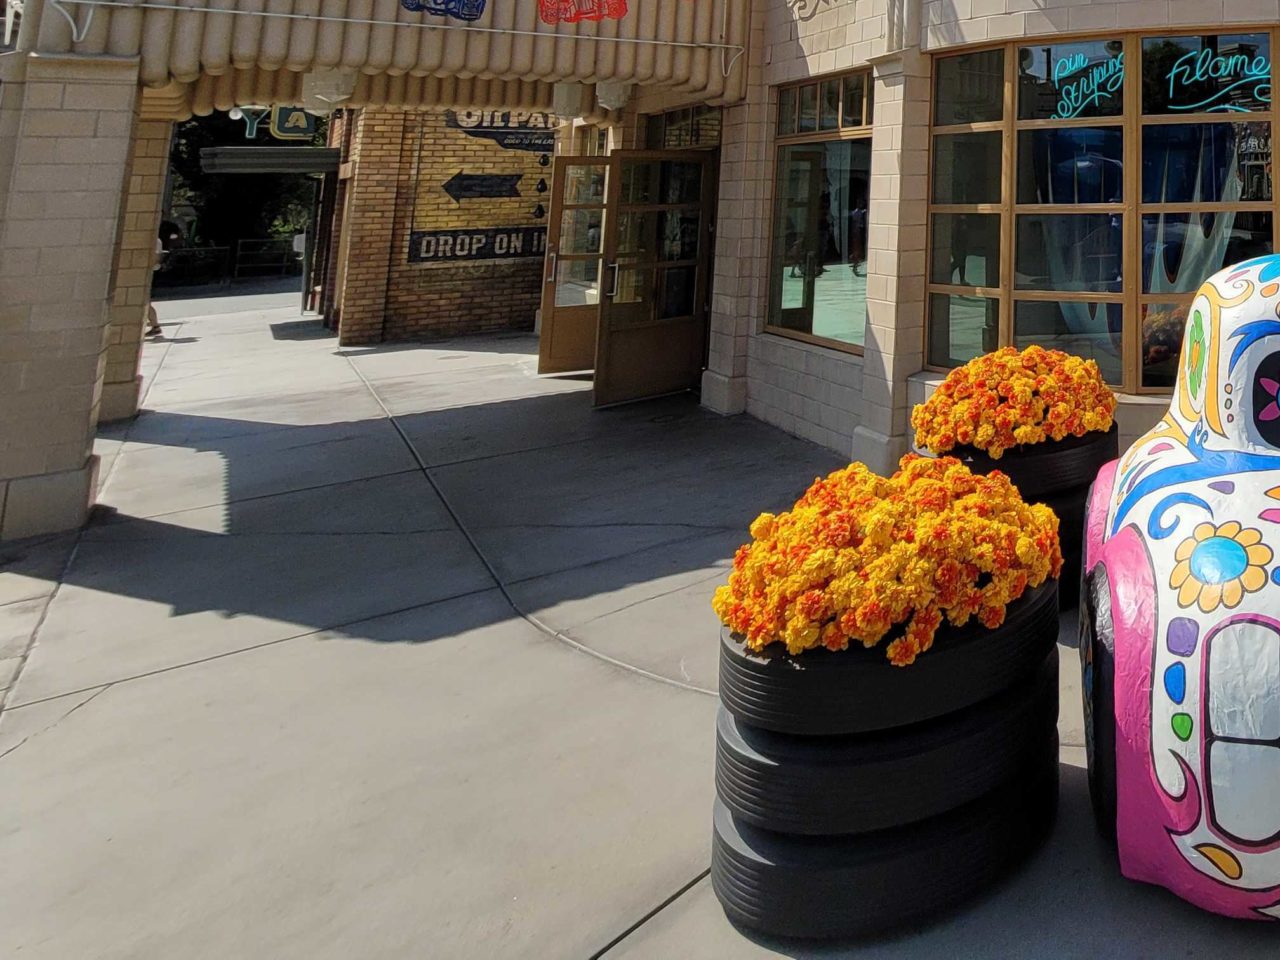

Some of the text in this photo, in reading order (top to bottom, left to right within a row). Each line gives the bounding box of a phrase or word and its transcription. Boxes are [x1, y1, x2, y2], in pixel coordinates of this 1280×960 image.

[1165, 48, 1271, 99] Flame
[420, 234, 486, 258] DROP
[494, 232, 524, 254] ON
